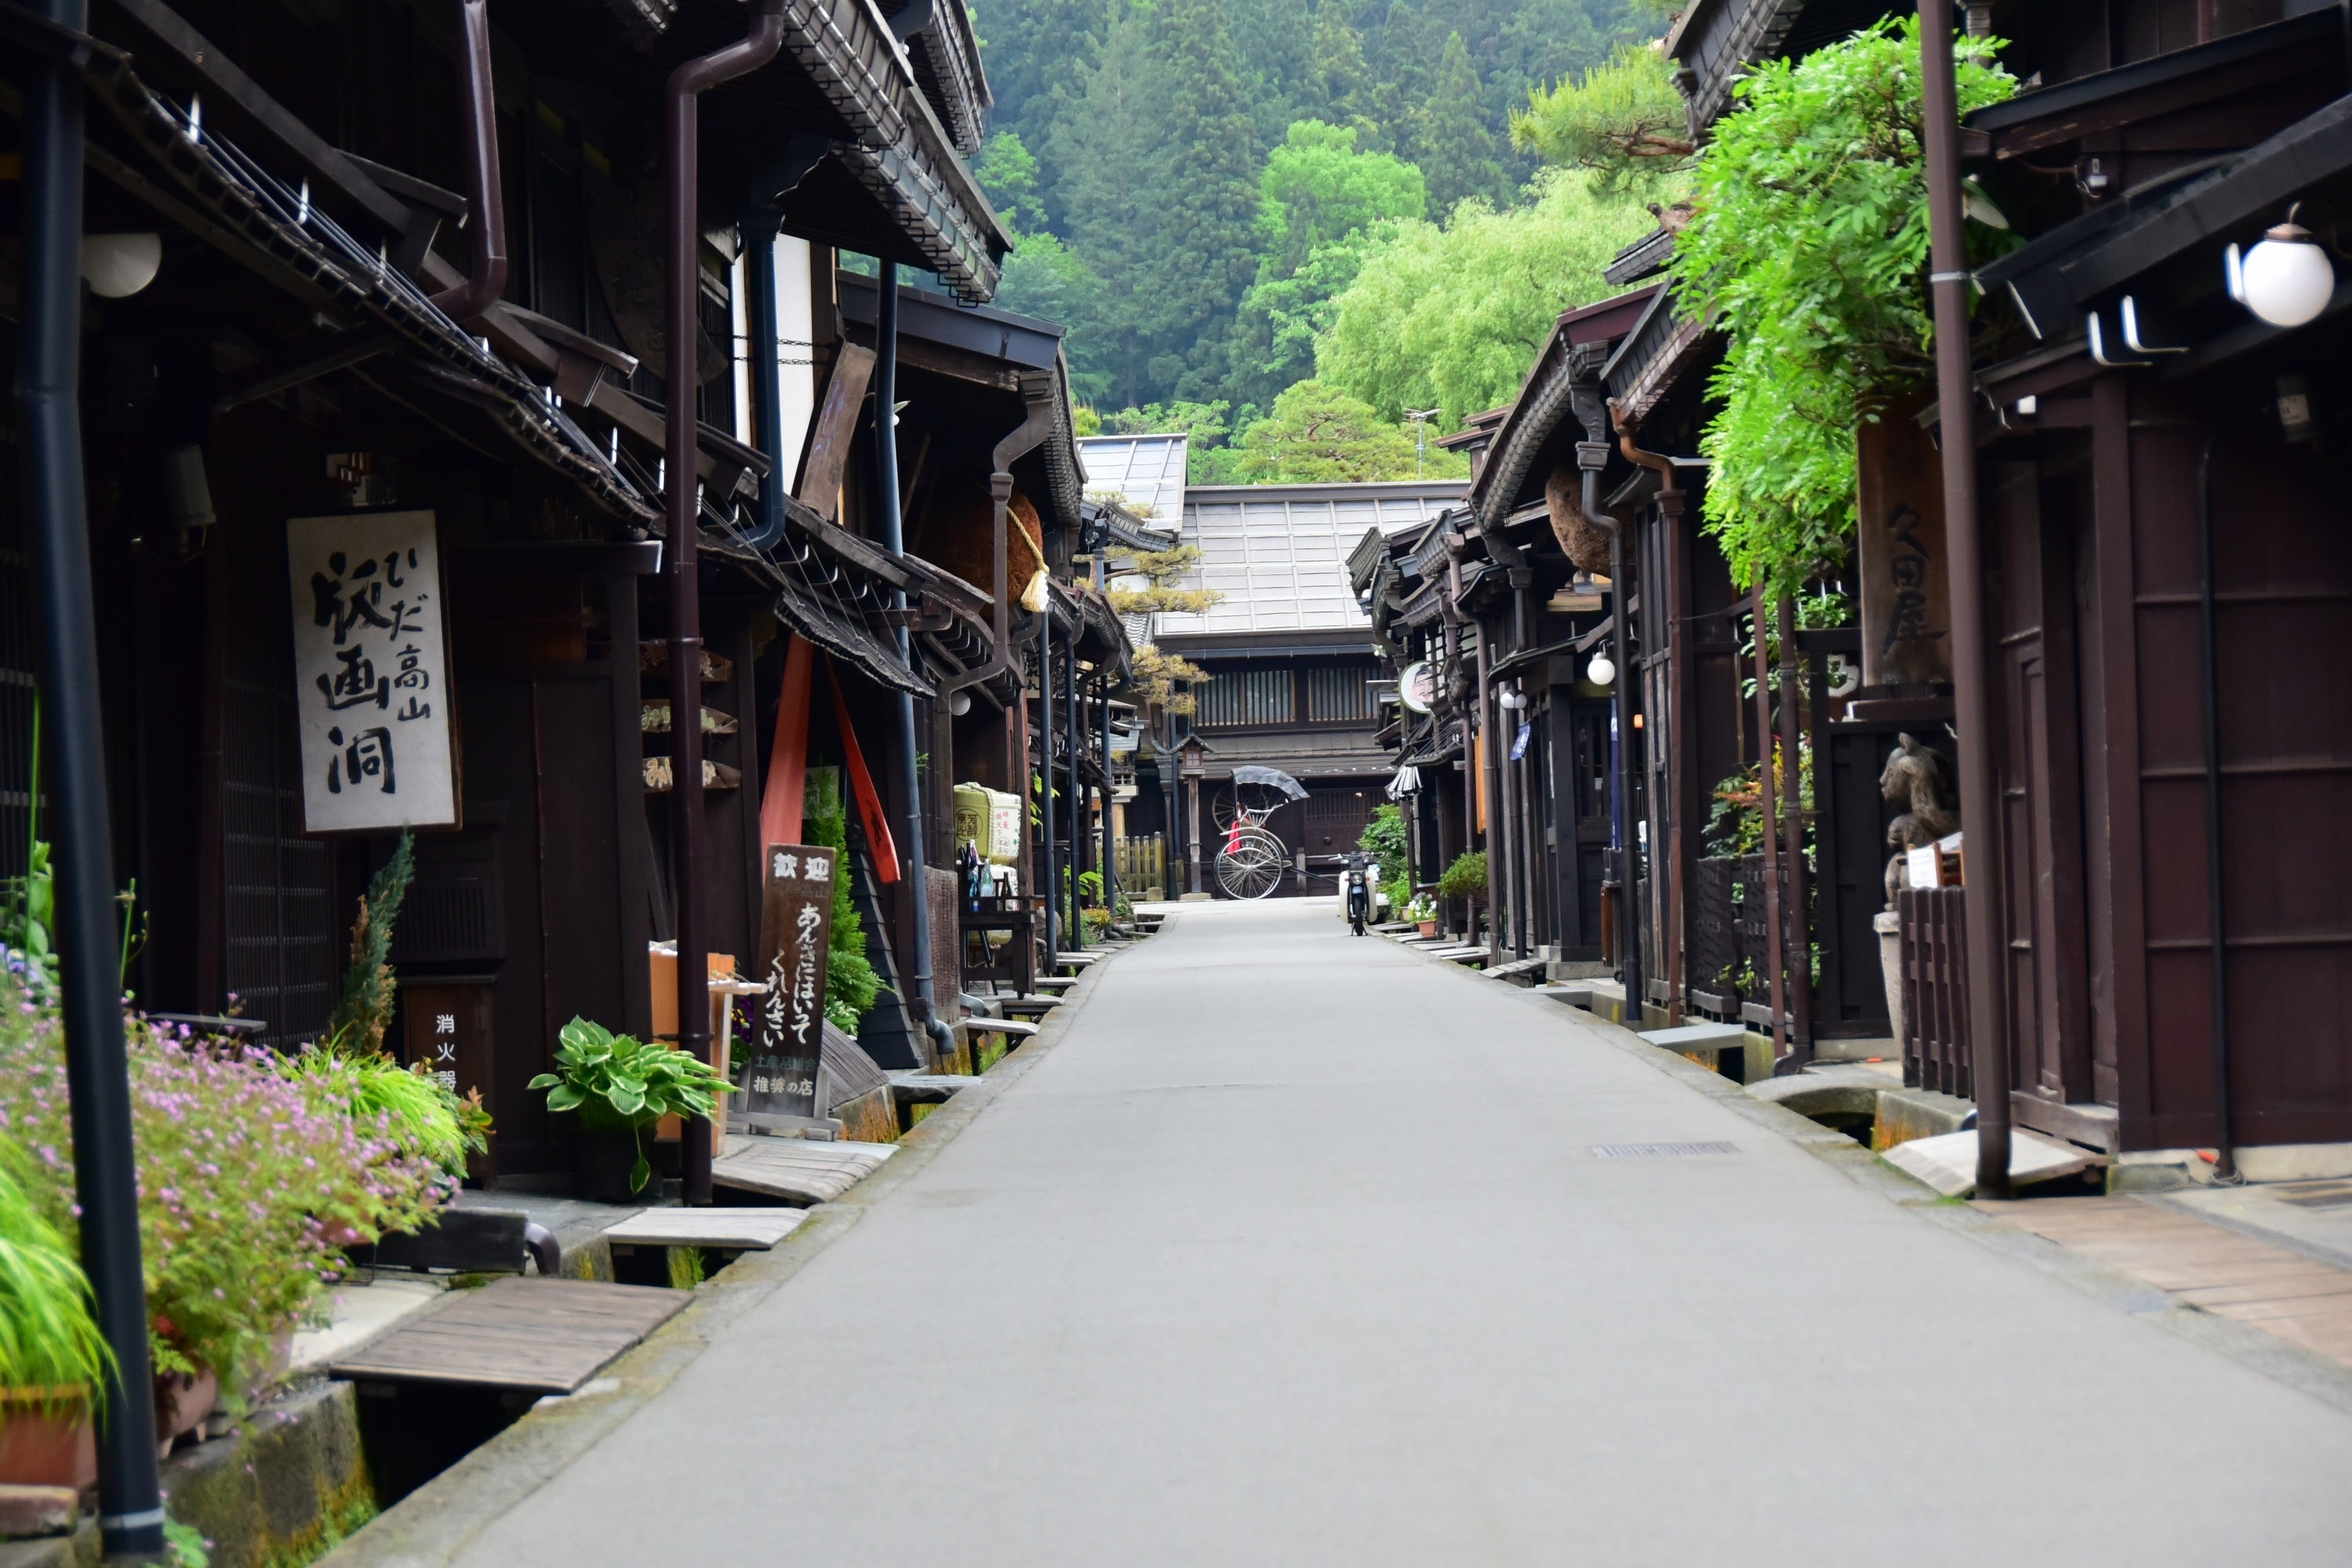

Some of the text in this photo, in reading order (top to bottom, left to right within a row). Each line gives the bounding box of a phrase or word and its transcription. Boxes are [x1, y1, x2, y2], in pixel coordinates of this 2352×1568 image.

[310, 550, 396, 794] 版画洞
[383, 547, 430, 721] ひだ高山
[773, 852, 829, 882] 歓迎
[763, 948, 789, 1047] くれんさい
[436, 1013, 457, 1089] 消火器
